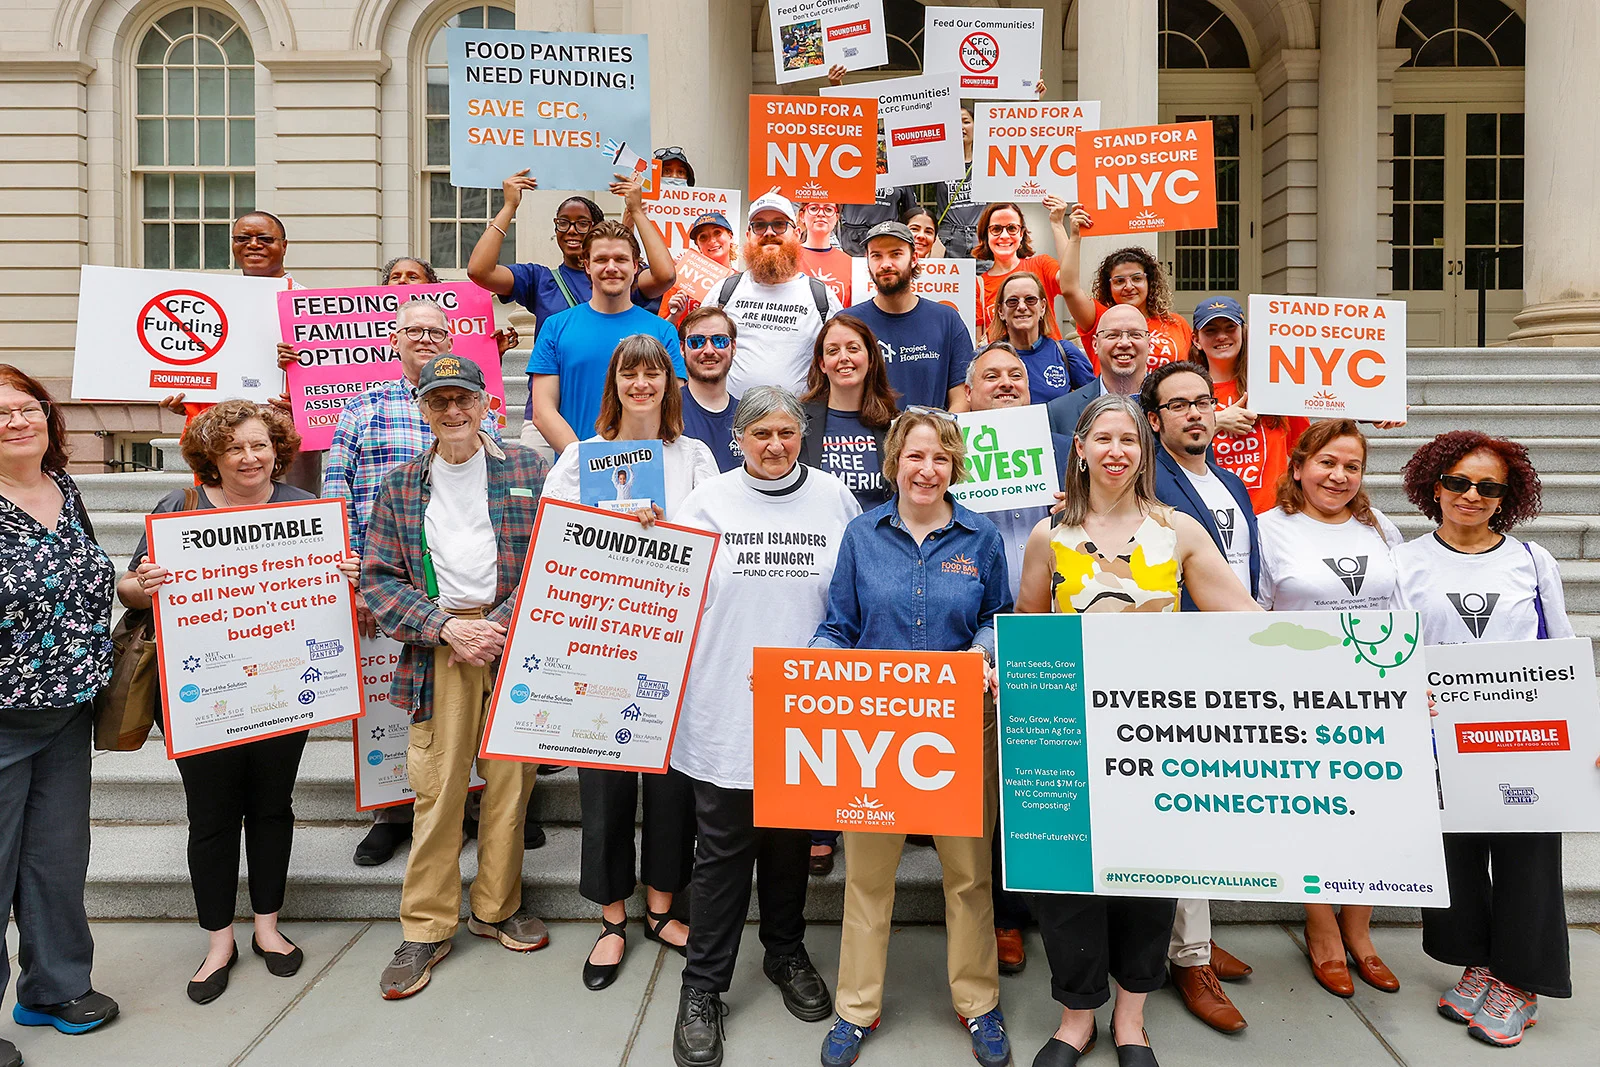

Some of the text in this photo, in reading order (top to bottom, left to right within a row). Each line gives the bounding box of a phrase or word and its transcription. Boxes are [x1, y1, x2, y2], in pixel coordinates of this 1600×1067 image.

[793, 2, 860, 20] Don't Cut CFC Funding!
[933, 19, 1035, 29] Feed Our Communities!
[971, 37, 989, 46] CFC
[465, 42, 632, 63] FOOD PANTRIES
[962, 48, 997, 57] Funding
[969, 58, 989, 66] Cuts
[466, 67, 634, 90] NEED FUNDING!
[879, 87, 950, 104] Communities!
[468, 99, 588, 120] SAVE CFC,
[767, 102, 863, 117] STAND FOR A
[885, 101, 932, 113] CFC Funding!
[468, 128, 601, 148] SAVE LIVES!
[767, 123, 862, 137] FOOD SECURE
[1093, 129, 1197, 149] STAND FOR A
[767, 142, 862, 178] NYC
[1095, 149, 1198, 168] FOOD SECURE
[1096, 169, 1199, 210] NYC
[166, 300, 205, 314] CFC
[735, 300, 808, 315] STATEN ISLANDERS
[1269, 301, 1386, 319] STAND FOR A
[145, 317, 224, 337] Funding
[742, 312, 797, 325] ARE HUNGRY!
[1270, 324, 1385, 340] FOOD SECURE
[161, 337, 205, 351] Cuts
[900, 344, 940, 362] Project Hospitality
[1270, 345, 1385, 388] NYC
[305, 382, 362, 395] RESTORE
[590, 449, 652, 470] LIVE UNITED
[969, 483, 1046, 499] FOOD FOR NYC
[190, 518, 323, 549] ROUNDTABLE
[725, 532, 827, 547] STATEN ISLANDERS
[573, 524, 693, 566] ROUNDTABLE
[203, 551, 343, 579] brings fresh food
[608, 554, 629, 562] ALLIES
[646, 560, 663, 568] FOOD
[666, 565, 689, 573] ACCESS
[737, 552, 814, 565] ARE HUNGRY!
[545, 560, 690, 598] Our community is
[169, 572, 340, 605] to all New Yorkers in
[178, 594, 337, 627] need; Don't cut the
[547, 585, 678, 622] hungry; Cutting
[228, 620, 296, 641] budget!
[530, 609, 684, 644] CFC will STARVE all
[567, 641, 638, 660] pantries
[783, 660, 956, 684] STAND FOR A
[1028, 661, 1053, 669] Seeds,
[1040, 672, 1076, 680] Empower
[1427, 665, 1575, 686] Communities!
[1065, 683, 1077, 691] Ag!
[1440, 688, 1538, 702] CFC Funding!
[784, 695, 955, 718] FOOD SECURE
[1092, 690, 1408, 711] DIVERSE DIETS, HEALTHY
[227, 711, 314, 735] theroundtablenyc.org
[1009, 716, 1027, 724] Sow,
[1029, 716, 1052, 724] Grow,
[1051, 728, 1062, 736] Ag
[1117, 724, 1385, 745] COMMUNITIES: $60M
[539, 743, 621, 758] theroundtablenyc.org
[1039, 738, 1082, 746] Tomorrow!
[785, 728, 956, 790] NYC
[1106, 758, 1403, 780] FOR COMMUNITY FOOD
[1057, 779, 1073, 787] $7M
[1033, 790, 1077, 800] Community
[1154, 793, 1356, 815] CONNECTIONS.
[836, 809, 895, 821] FOOD BANK
[1022, 801, 1071, 811] Composting!
[1010, 832, 1087, 841] FeedtheFutureNYC!
[1106, 872, 1278, 888] #NYCFOODPOLICYALLIANCE
[1324, 879, 1433, 893] equity advocates
